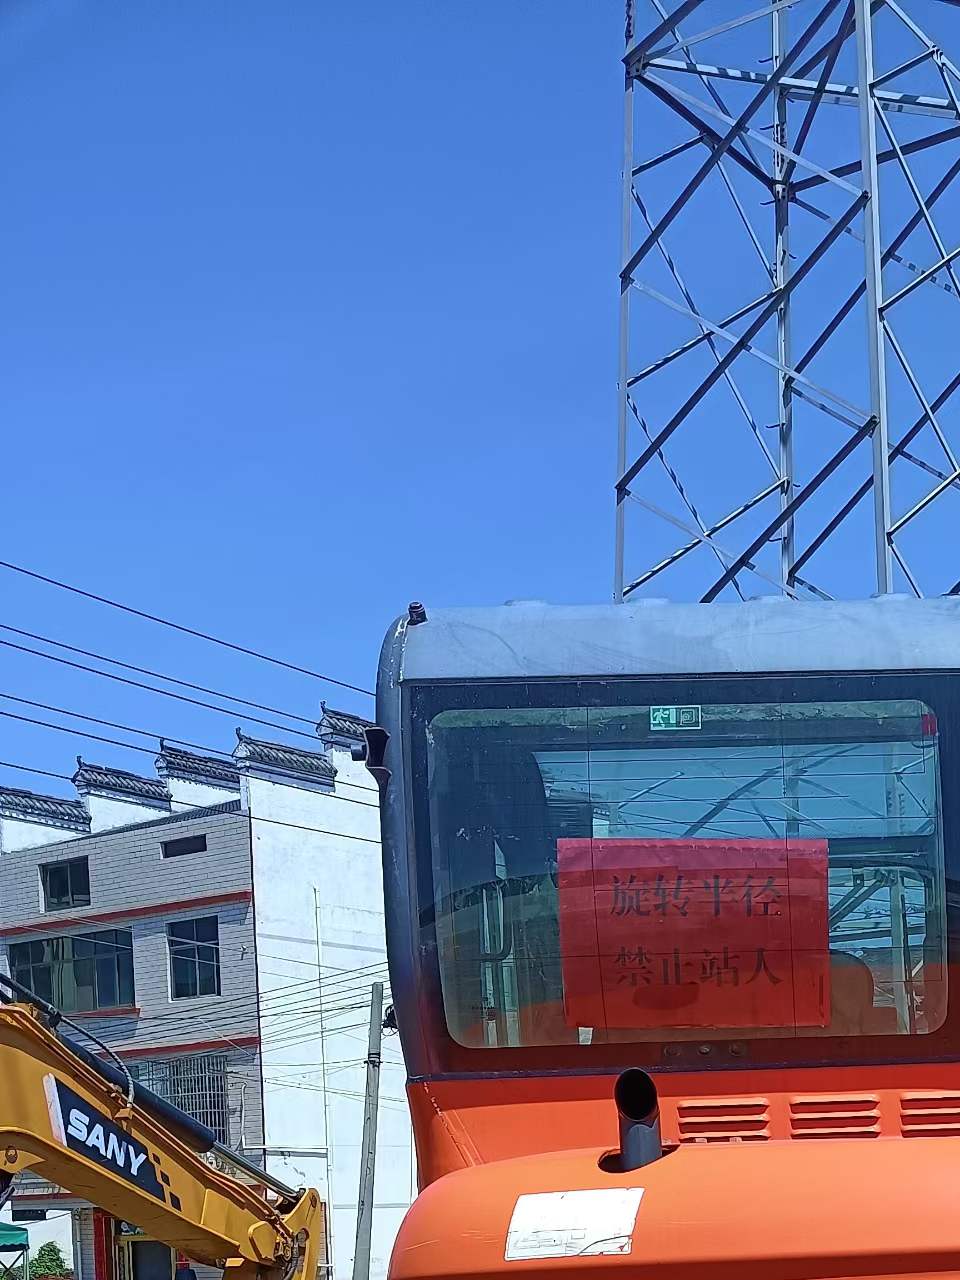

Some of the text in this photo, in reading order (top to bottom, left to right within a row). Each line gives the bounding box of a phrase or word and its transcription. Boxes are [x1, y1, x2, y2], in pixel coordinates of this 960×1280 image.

[610, 874, 782, 917] 旋转半径
[614, 946, 784, 986] 禁止站人
[67, 1108, 147, 1176] SANY
